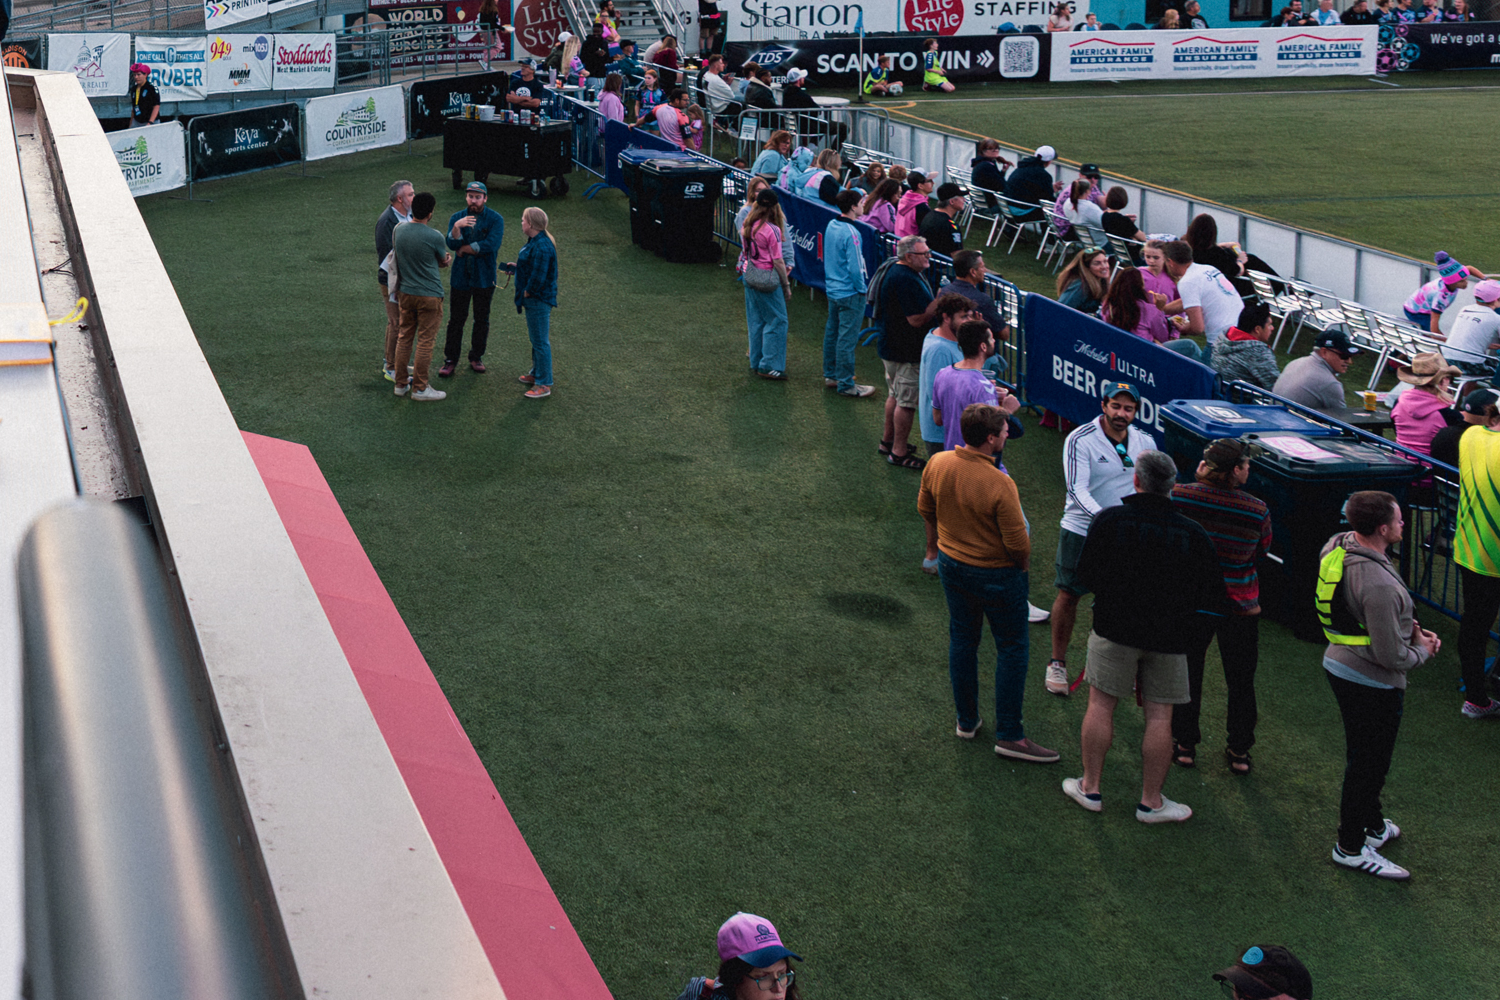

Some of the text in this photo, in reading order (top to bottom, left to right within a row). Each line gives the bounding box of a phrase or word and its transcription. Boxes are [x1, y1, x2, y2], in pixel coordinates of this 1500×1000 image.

[522, 0, 568, 26] Life
[974, 1, 1076, 16] STAFFING
[388, 8, 444, 26] WORLD
[911, 10, 960, 34] Style
[389, 38, 444, 53] BURGRS
[1431, 32, 1494, 46] We've got a
[276, 43, 332, 65] Stoddard's
[1120, 47, 1154, 55] FAMILY
[1173, 45, 1258, 54] AMERICAN FAMILY
[1277, 42, 1362, 52] AMERICAN FAMILY
[139, 53, 155, 61] ONE
[156, 52, 169, 60] CALL
[757, 52, 784, 64] TDS
[817, 53, 879, 74] SCAN
[884, 52, 918, 72] TO
[229, 69, 251, 79] MMM
[326, 120, 386, 142] COUNTRYSIDE
[225, 141, 269, 155] sports center
[1074, 339, 1156, 387] Michelob ULTRA
[1052, 354, 1097, 398] BEER
